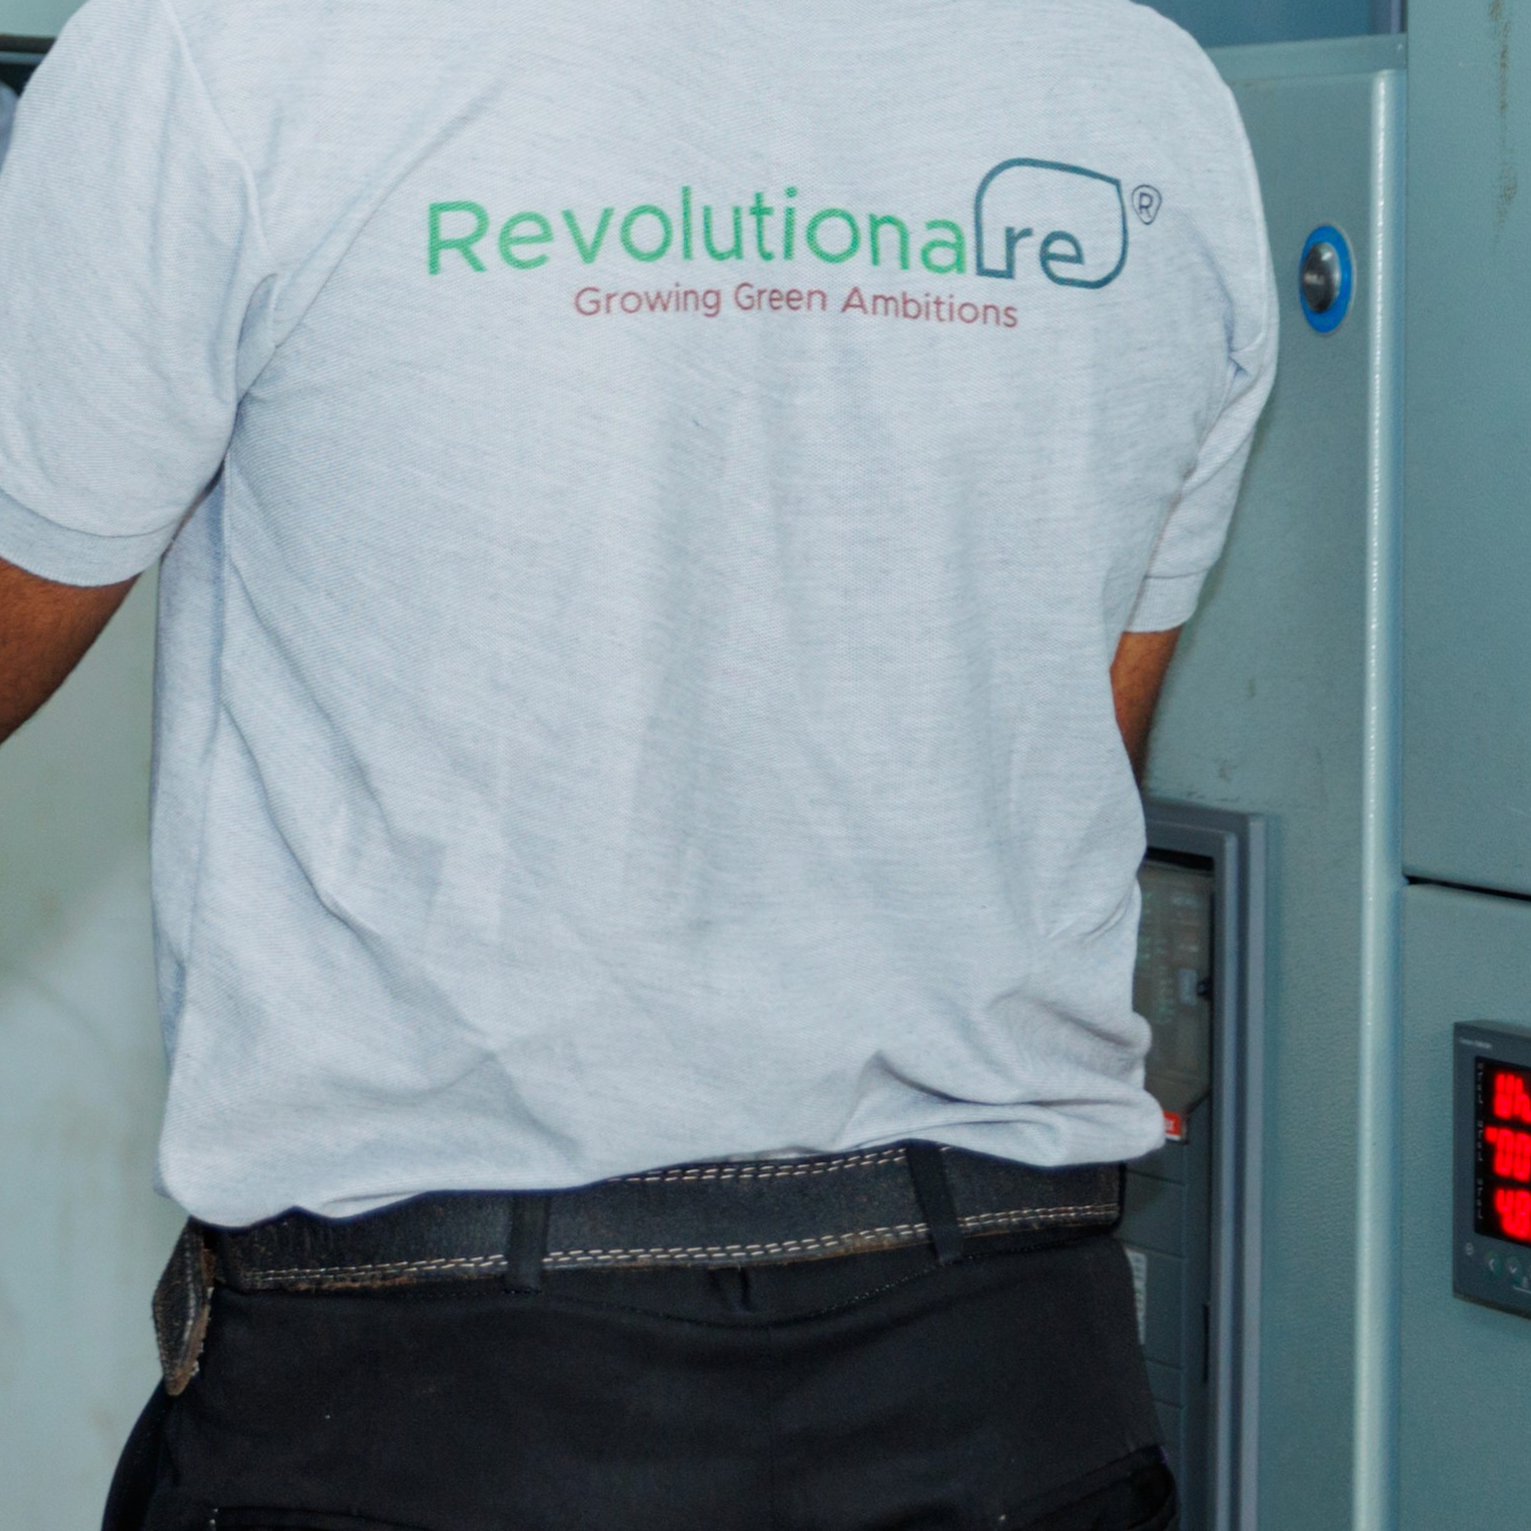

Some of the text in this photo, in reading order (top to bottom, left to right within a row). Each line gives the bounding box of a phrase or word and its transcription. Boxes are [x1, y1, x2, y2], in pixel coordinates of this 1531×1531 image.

[574, 281, 1019, 328] Growing Green Ambitions
